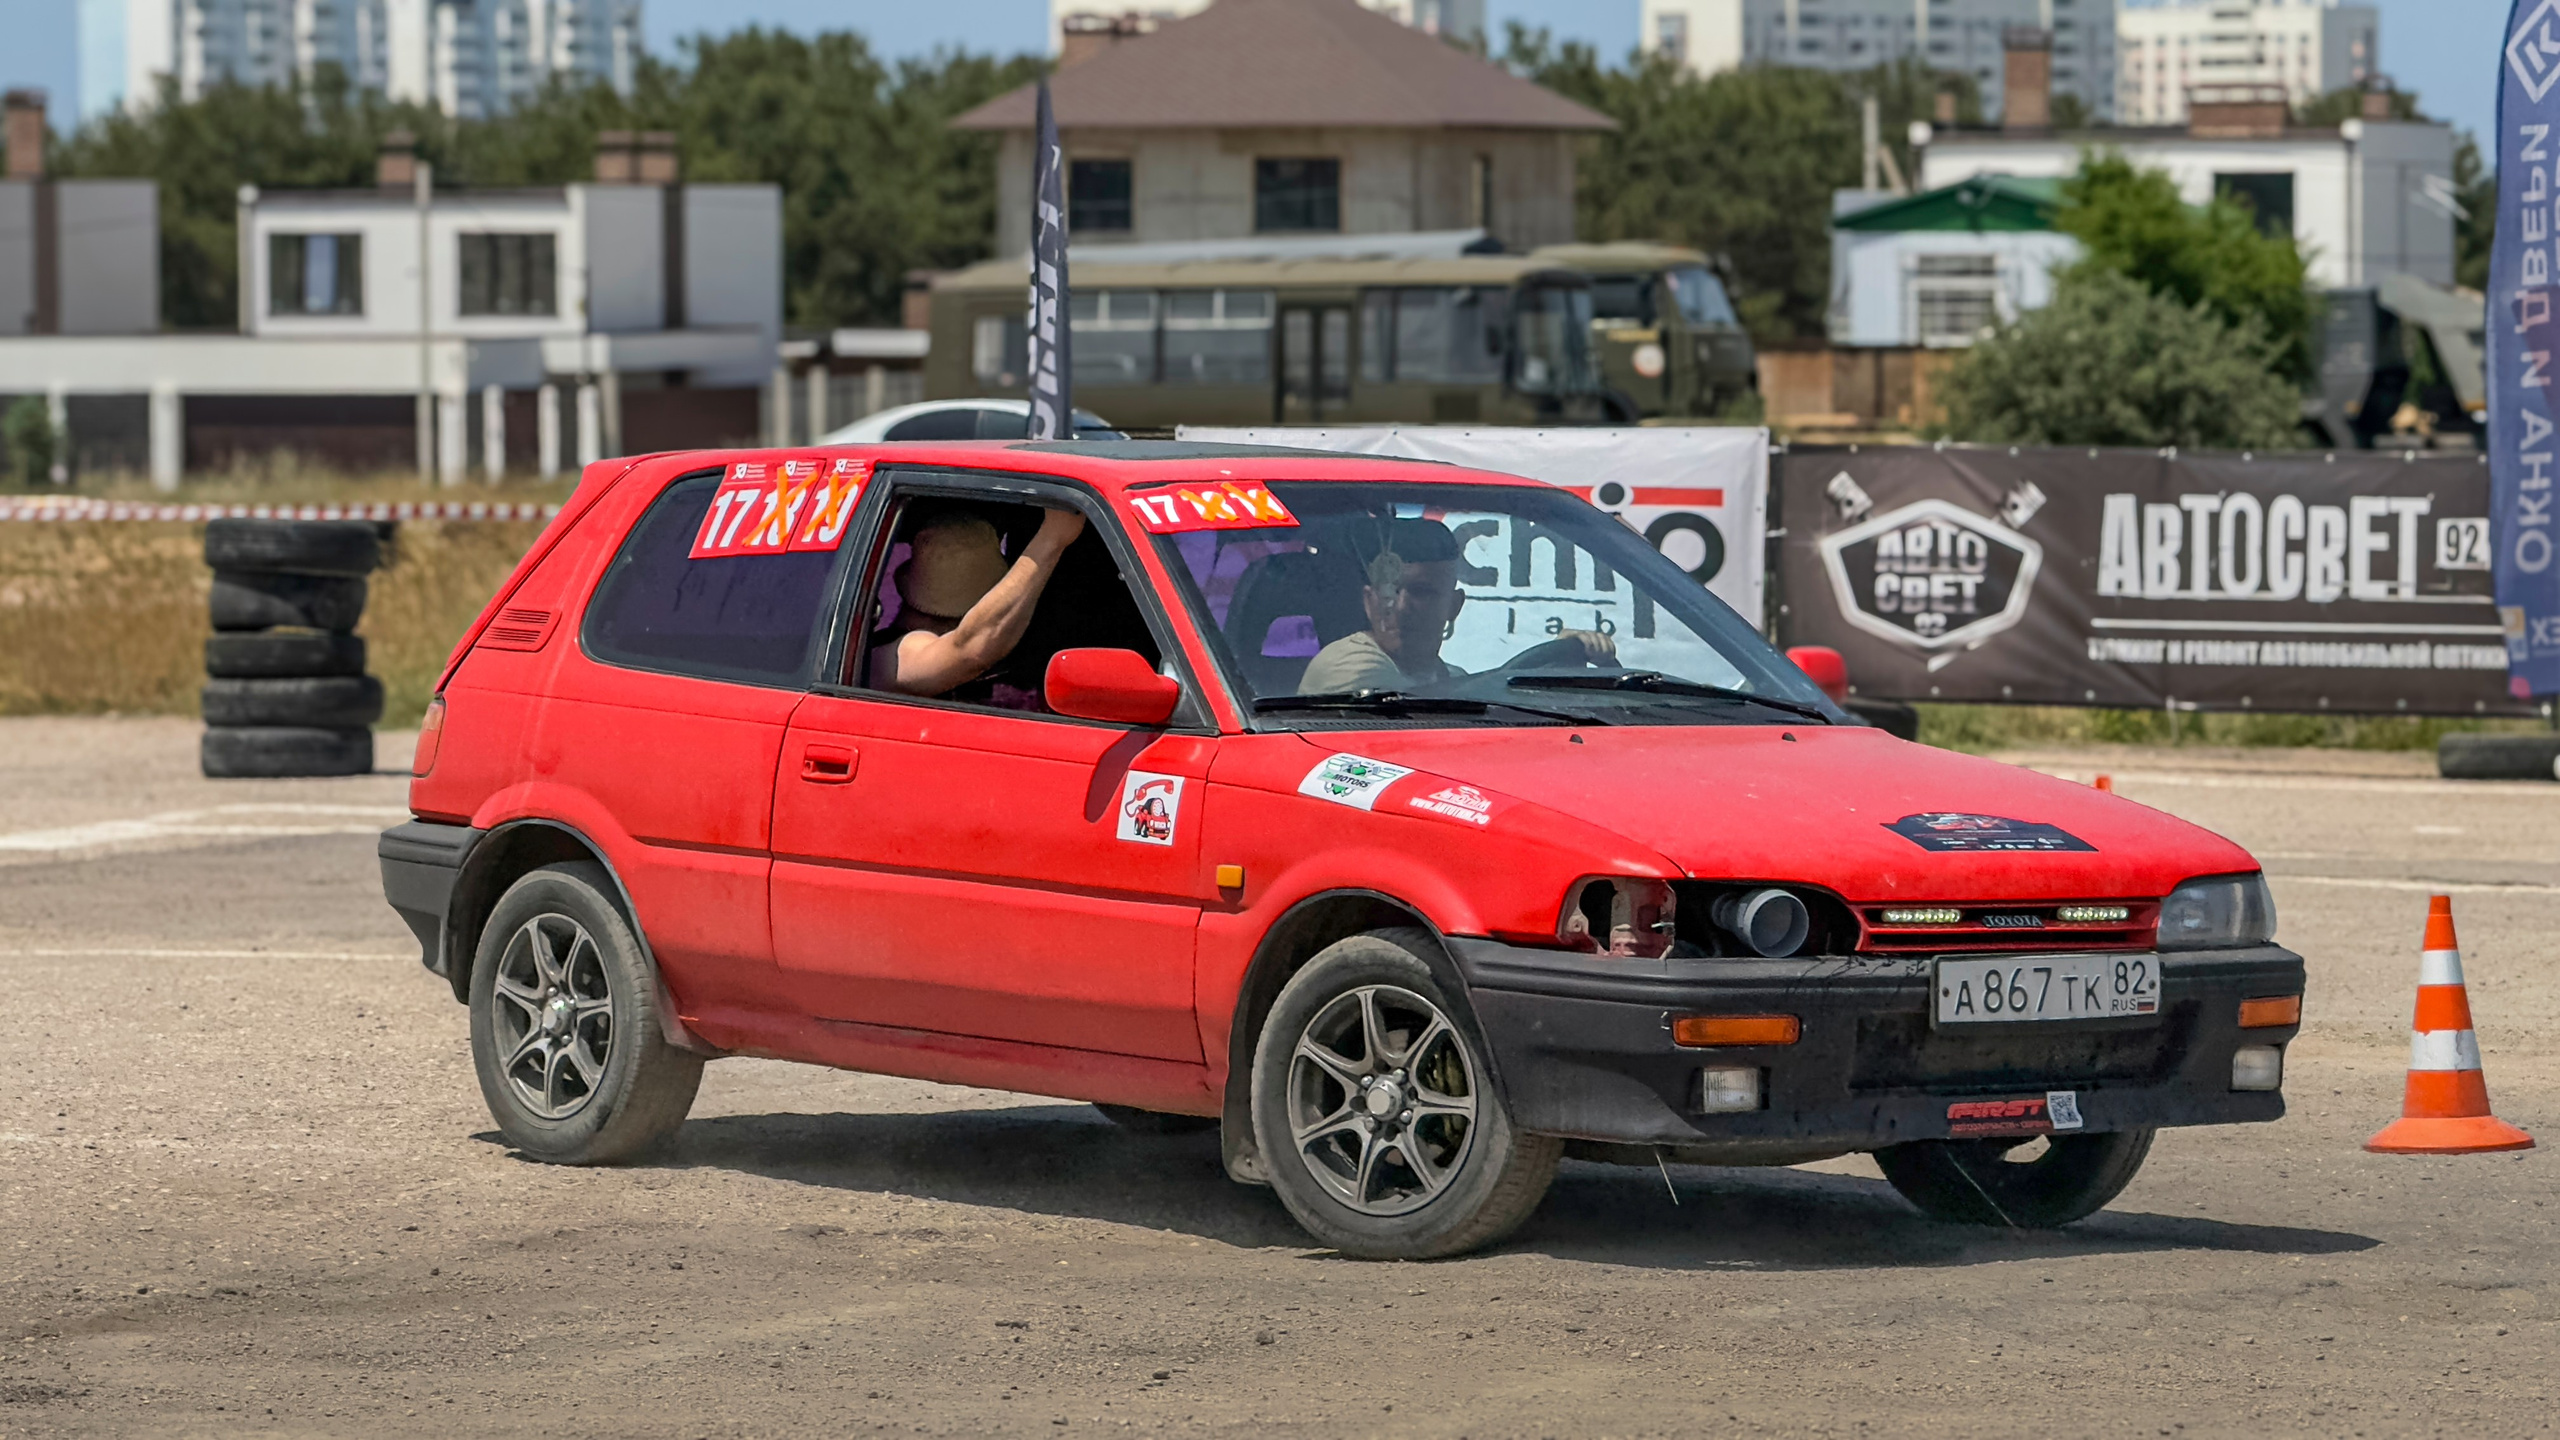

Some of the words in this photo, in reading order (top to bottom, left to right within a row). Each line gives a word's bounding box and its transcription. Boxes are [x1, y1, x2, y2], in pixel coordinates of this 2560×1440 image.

[702, 488, 761, 549] 17
[1130, 495, 1181, 525] 17
[1874, 521, 1988, 573] АВТО
[2445, 524, 2479, 564] 92
[1874, 572, 1985, 614] СВЕТ
[2184, 640, 2259, 666] РЕМОНТ
[1985, 914, 2043, 928] TOYOTA
[2114, 960, 2147, 995] 82
[2111, 998, 2136, 1012] RUS
